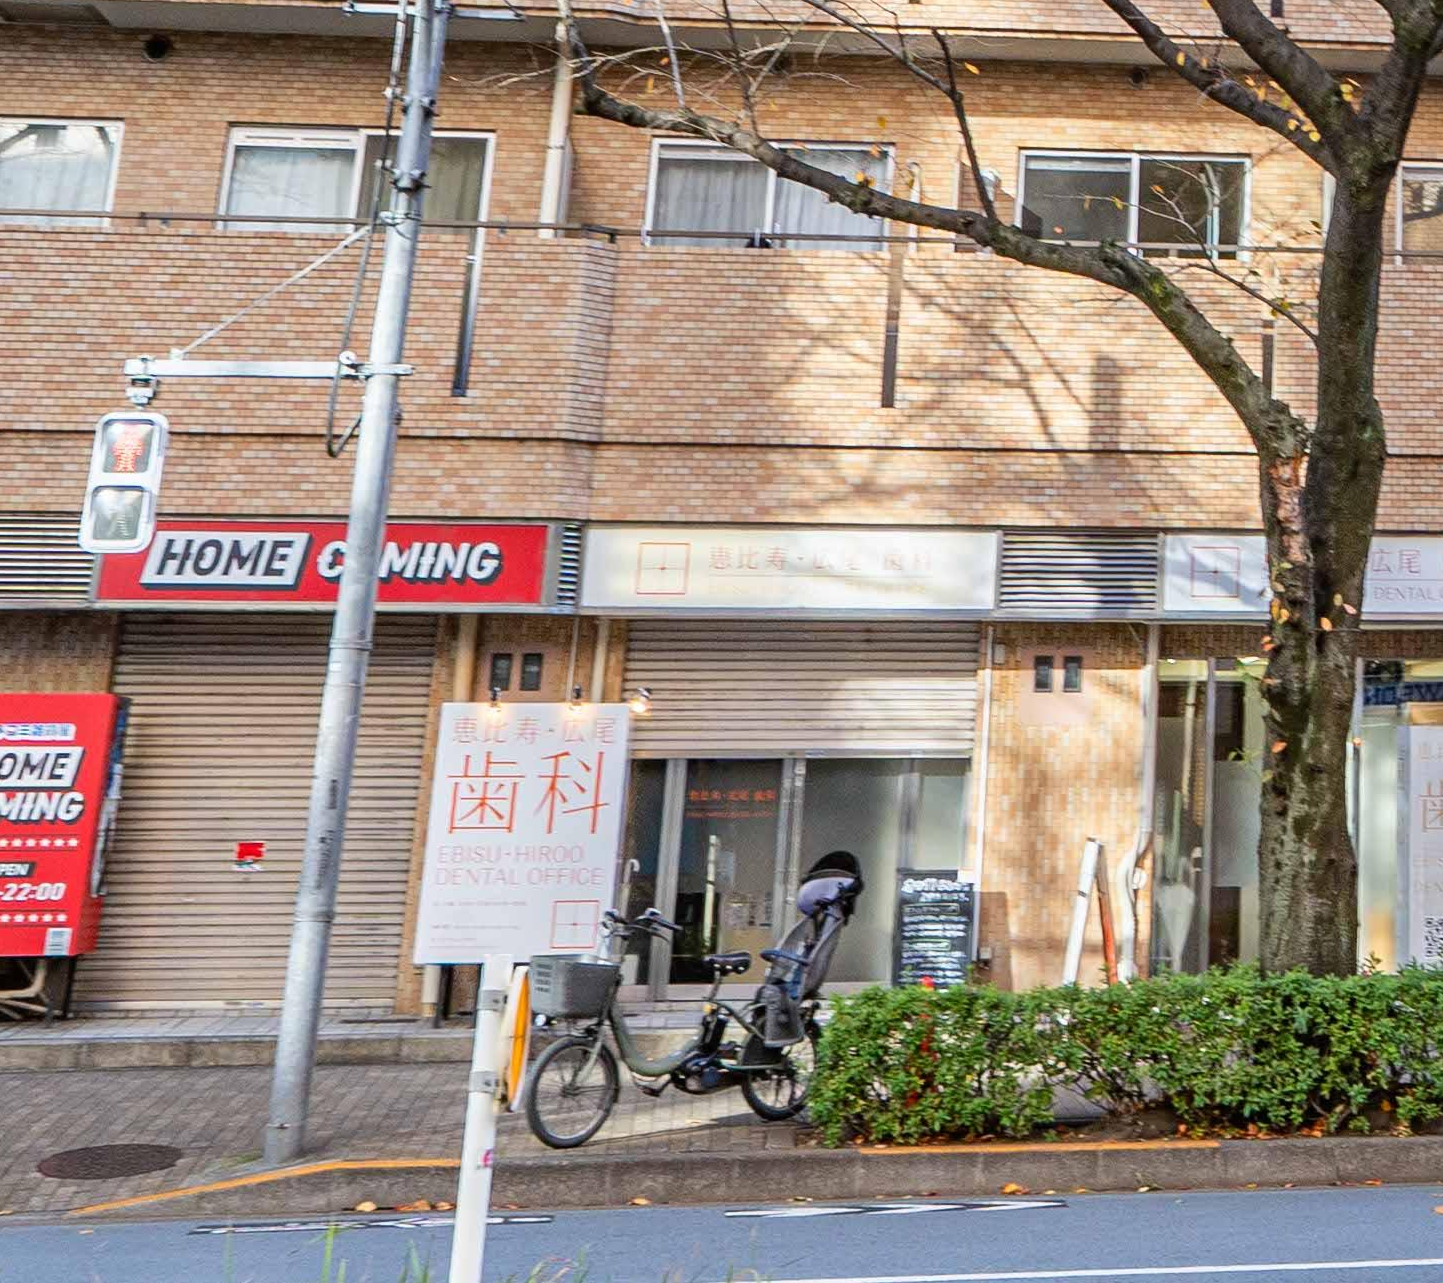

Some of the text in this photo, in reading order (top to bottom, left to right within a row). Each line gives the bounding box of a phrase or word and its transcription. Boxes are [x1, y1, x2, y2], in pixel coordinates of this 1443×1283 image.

[155, 537, 501, 581] HOME CMING
[1373, 586, 1436, 603] DENTAL
[445, 750, 611, 834] 歯科
[435, 867, 607, 886] DENTAL OFFICE
